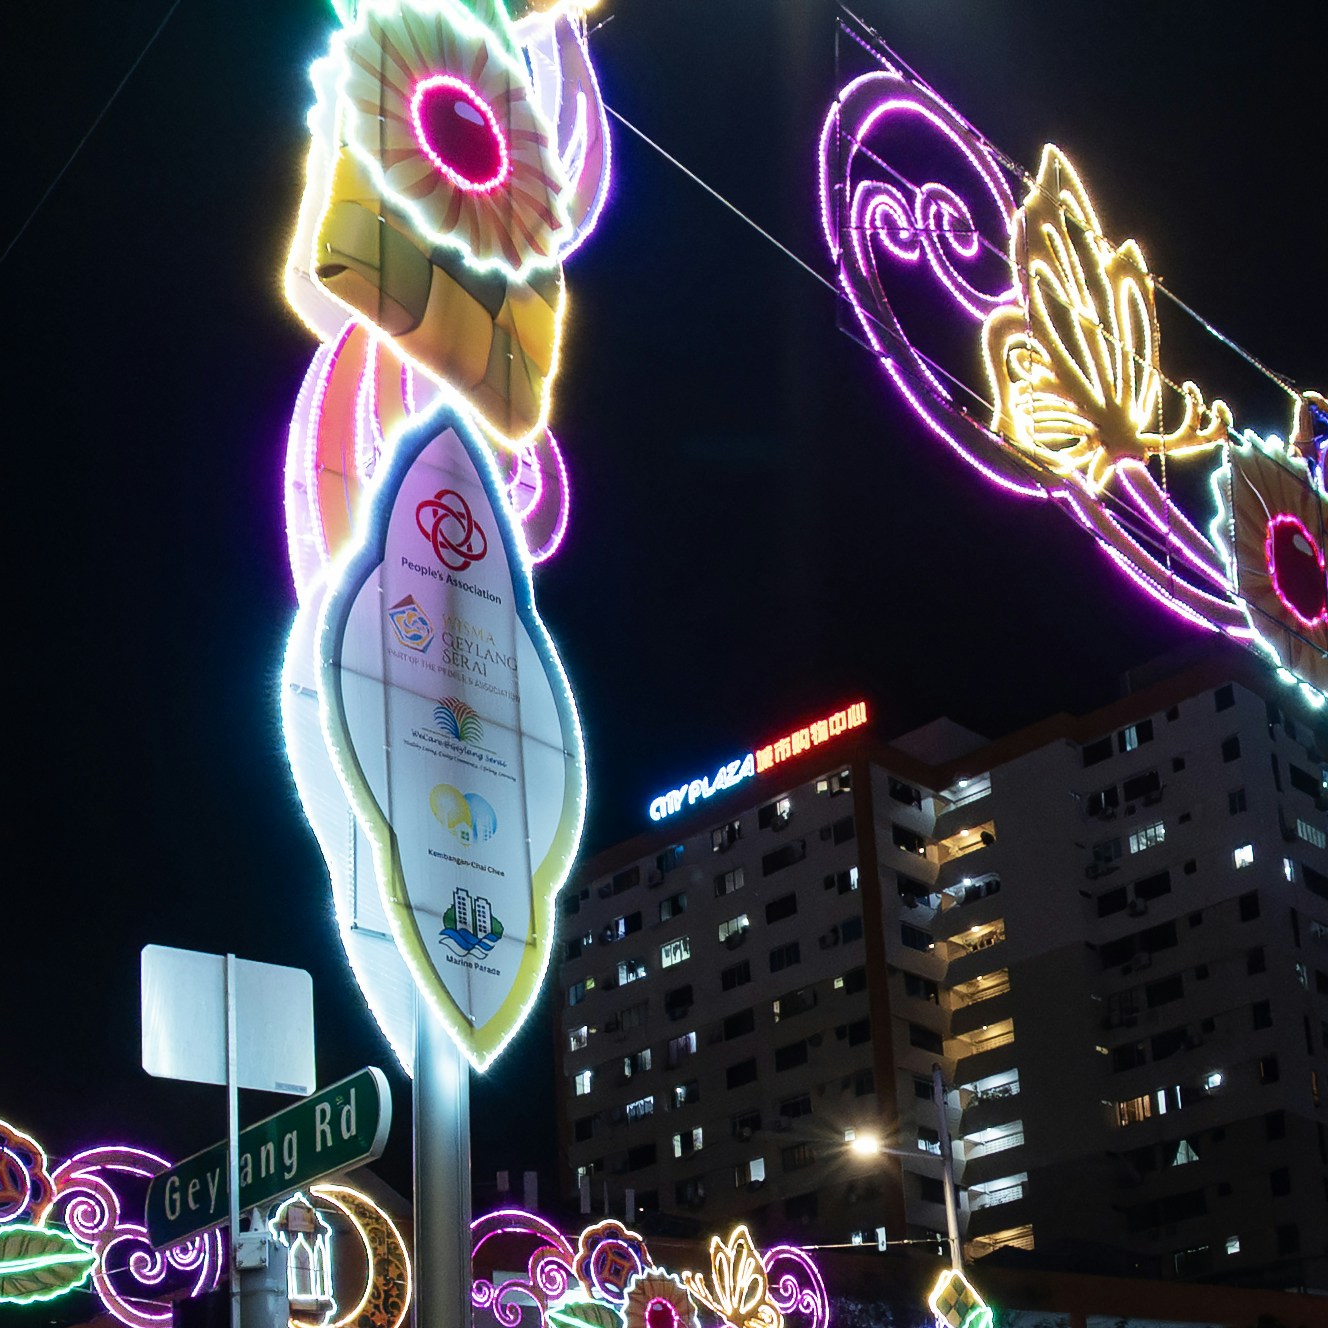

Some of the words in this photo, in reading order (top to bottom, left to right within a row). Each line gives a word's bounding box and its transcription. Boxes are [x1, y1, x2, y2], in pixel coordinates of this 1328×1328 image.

[401, 556, 443, 581] People's
[446, 575, 502, 605] Association
[442, 613, 496, 646] WISMA
[442, 632, 518, 671] GEYLANG
[442, 649, 487, 677] SERAI
[649, 783, 688, 821] CITY
[687, 753, 755, 804] PLAZA
[488, 866, 505, 877] Chee
[446, 954, 473, 970] Marine
[474, 962, 501, 976] Parade
[165, 1130, 298, 1221] Geyang
[315, 1087, 357, 1152] Rd
